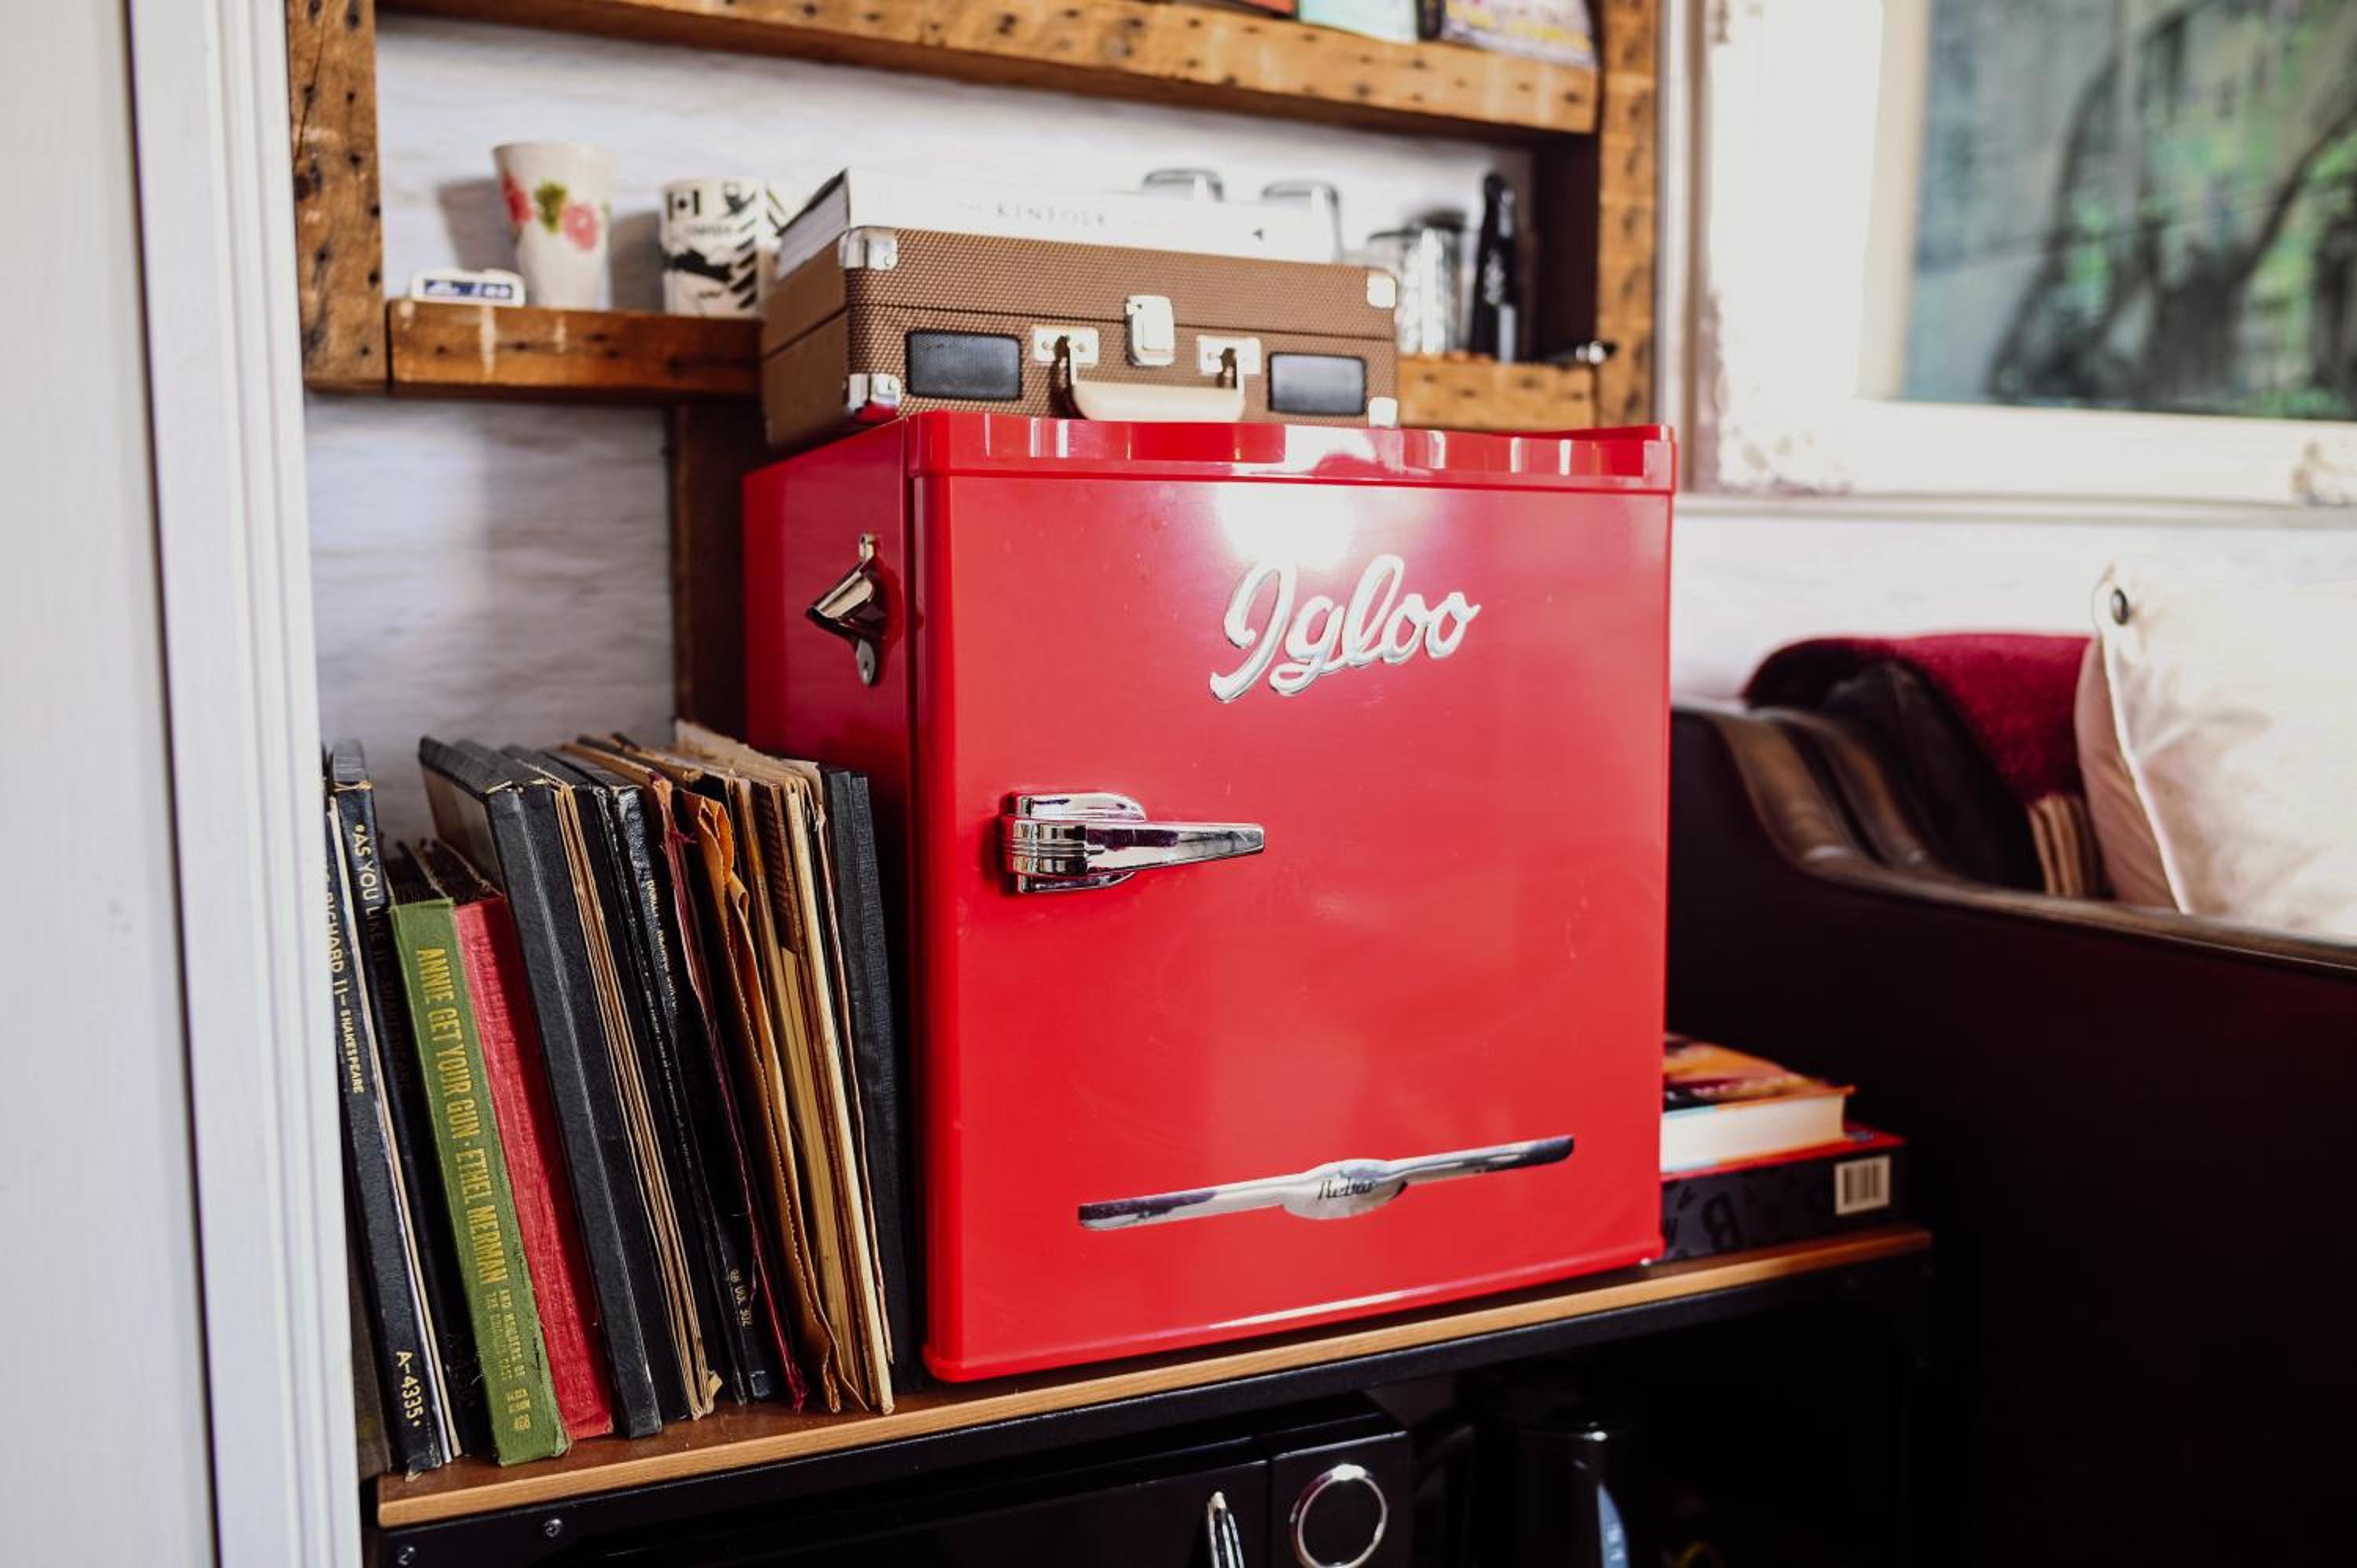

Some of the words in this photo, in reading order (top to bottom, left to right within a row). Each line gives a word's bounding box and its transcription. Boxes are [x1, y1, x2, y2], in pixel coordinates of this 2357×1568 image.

[1209, 553, 1482, 704] Igloo
[357, 860, 380, 902] YOU
[416, 947, 455, 1006] ANNIE
[340, 1009, 365, 1094] SHAKESPEARE
[427, 1006, 463, 1042] GET
[436, 1042, 473, 1098] YOUR
[447, 1099, 481, 1139] GUN
[456, 1147, 493, 1204] ETHEL
[467, 1204, 509, 1284] MERMAN
